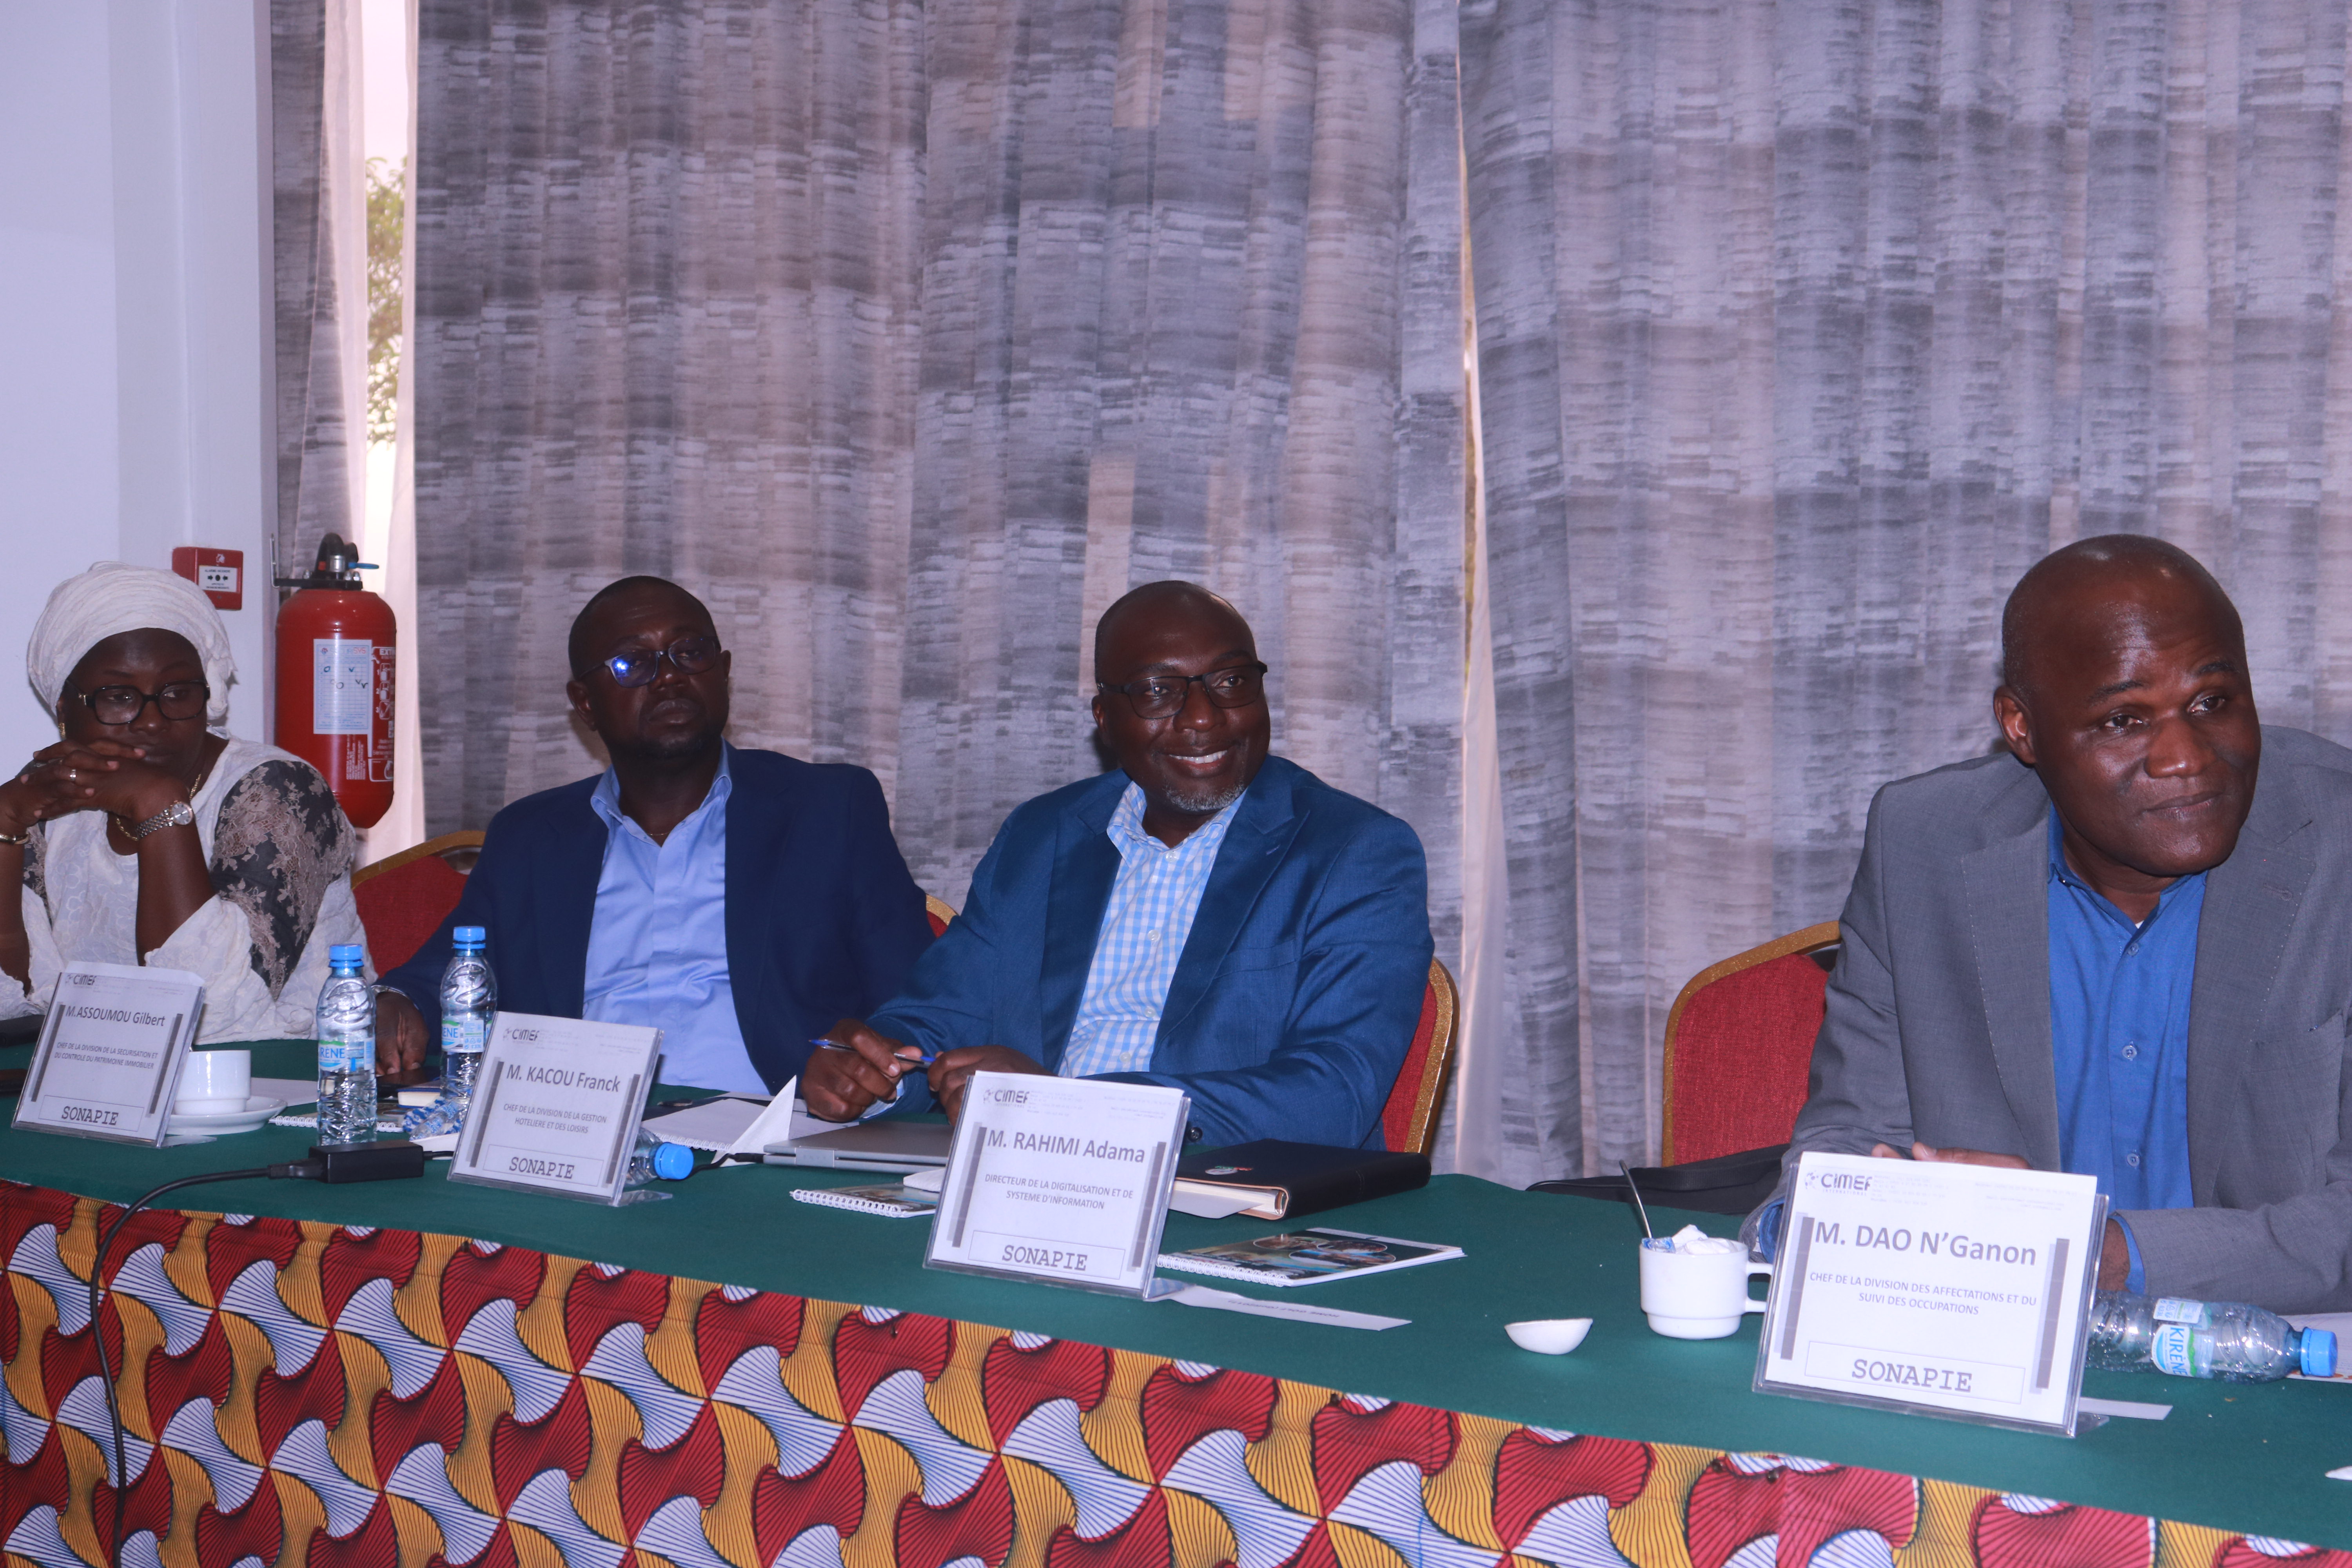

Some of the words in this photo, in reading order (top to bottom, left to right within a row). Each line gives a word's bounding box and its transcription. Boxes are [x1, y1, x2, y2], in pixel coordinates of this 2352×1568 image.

[132, 1011, 165, 1027] Gilbert
[62, 1053, 85, 1061] CONTROLE
[94, 1056, 124, 1066] PATRIMOINE
[124, 1060, 154, 1069] IMMOBILIER
[117, 1049, 151, 1058] SECURISATION
[506, 1064, 521, 1080] M.
[526, 1066, 574, 1086] KACOU
[577, 1073, 621, 1093] Franck
[62, 1105, 119, 1125] SONAPIE
[503, 1103, 518, 1112] CHEF
[536, 1108, 563, 1118] DIVISION
[581, 1114, 607, 1123] GESTION
[515, 1117, 546, 1128] HOTELIERE
[567, 1124, 589, 1134] LOISIRS
[987, 1129, 1007, 1148] M.
[1013, 1131, 1080, 1156] RAHIMI
[1083, 1140, 1145, 1163] Adama
[509, 1157, 575, 1179] SONAPIE
[985, 1174, 1027, 1187] DIRECTEUR
[1028, 1178, 1039, 1188] DE
[1040, 1180, 1049, 1189] LA
[1051, 1181, 1110, 1196] DIGITALISATION
[1111, 1188, 1122, 1198] ET
[1123, 1190, 1133, 1199] DE
[1006, 1190, 1040, 1203] SYSTEME
[1042, 1195, 1105, 1210] D’INFORMATION
[1815, 1221, 1846, 1246] M.
[1855, 1225, 1912, 1252] DAO
[1920, 1231, 2036, 1266] N’Ganon
[1002, 1244, 1087, 1272] SONAPIE
[1810, 1272, 1833, 1284] CHEF
[1835, 1274, 1848, 1285] DE
[1850, 1276, 1862, 1286] LA
[1864, 1278, 1908, 1292] DIVISION
[1911, 1283, 1930, 1294] DES
[1933, 1286, 2004, 1303] AFFECTATIONS
[2007, 1293, 2020, 1305] ET
[2022, 1296, 2037, 1306] DU
[1859, 1292, 1885, 1304] SUIVI
[1888, 1296, 1906, 1307] DES
[1909, 1298, 1980, 1316] OCCUPATIONS
[2169, 1327, 2189, 1376] KIRÈNE
[1851, 1359, 1973, 1393] SONAPIE
